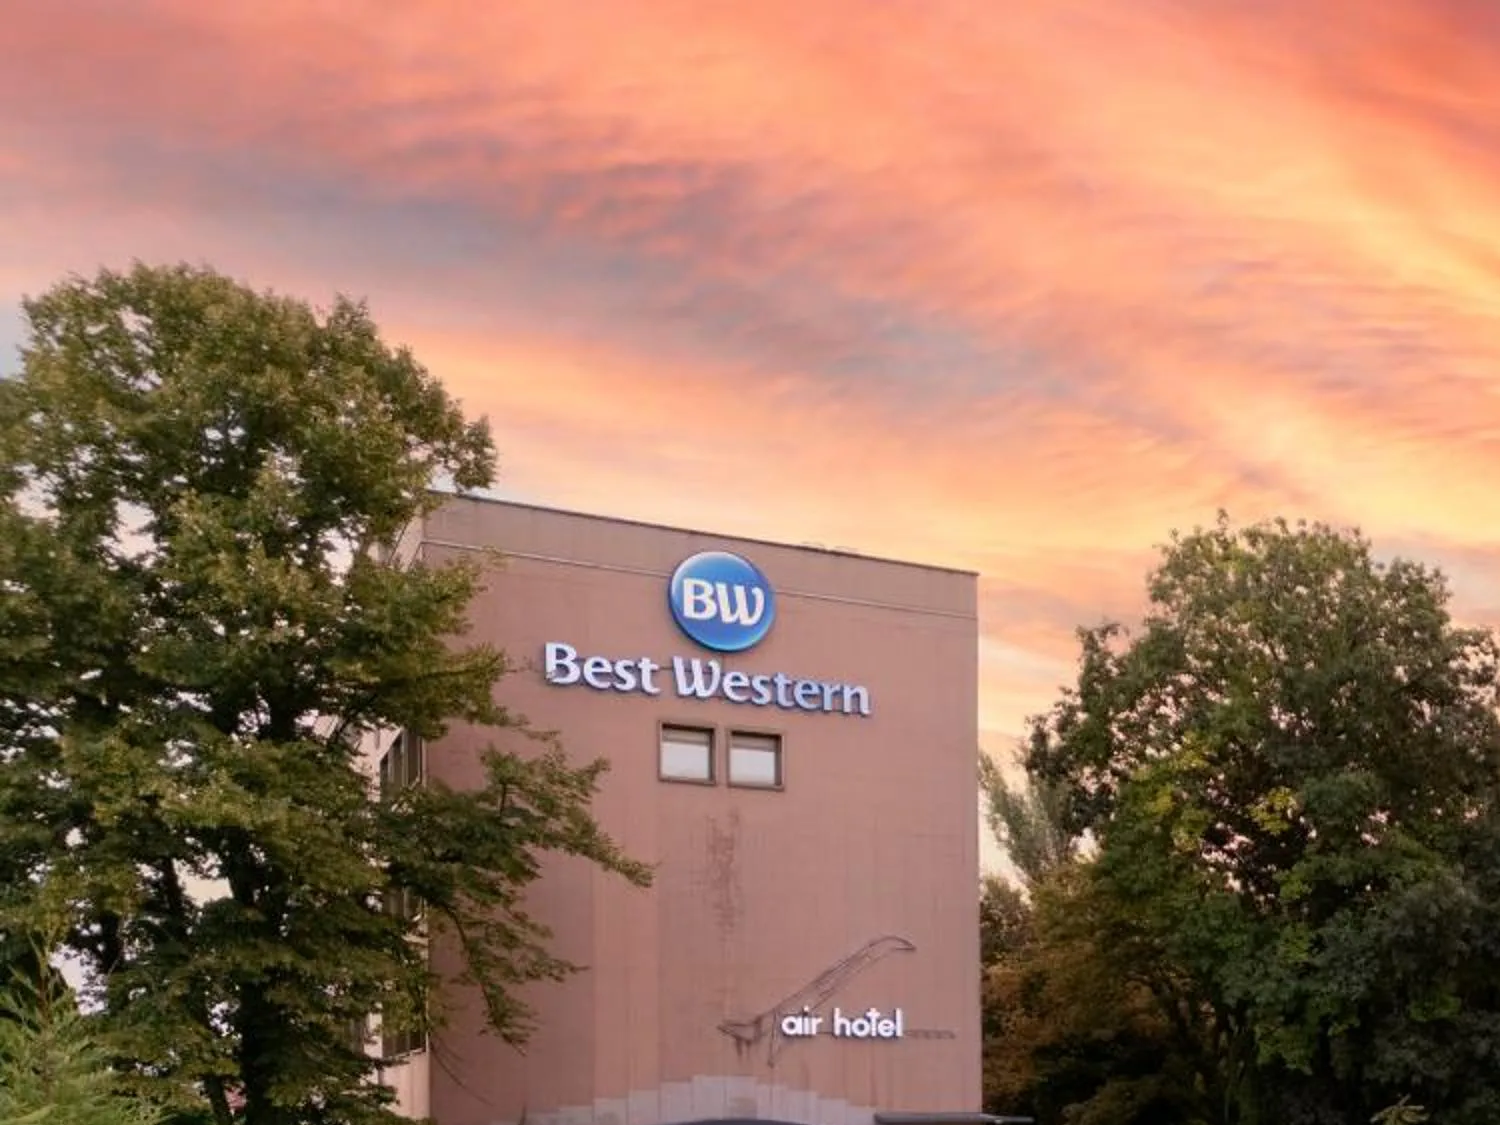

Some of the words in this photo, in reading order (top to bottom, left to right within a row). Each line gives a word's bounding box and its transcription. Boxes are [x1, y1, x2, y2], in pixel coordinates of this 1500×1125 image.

[683, 577, 765, 626] BW
[545, 642, 661, 695] Best
[672, 655, 871, 715] Western
[780, 1006, 822, 1036] air
[833, 1007, 903, 1038] hotel
